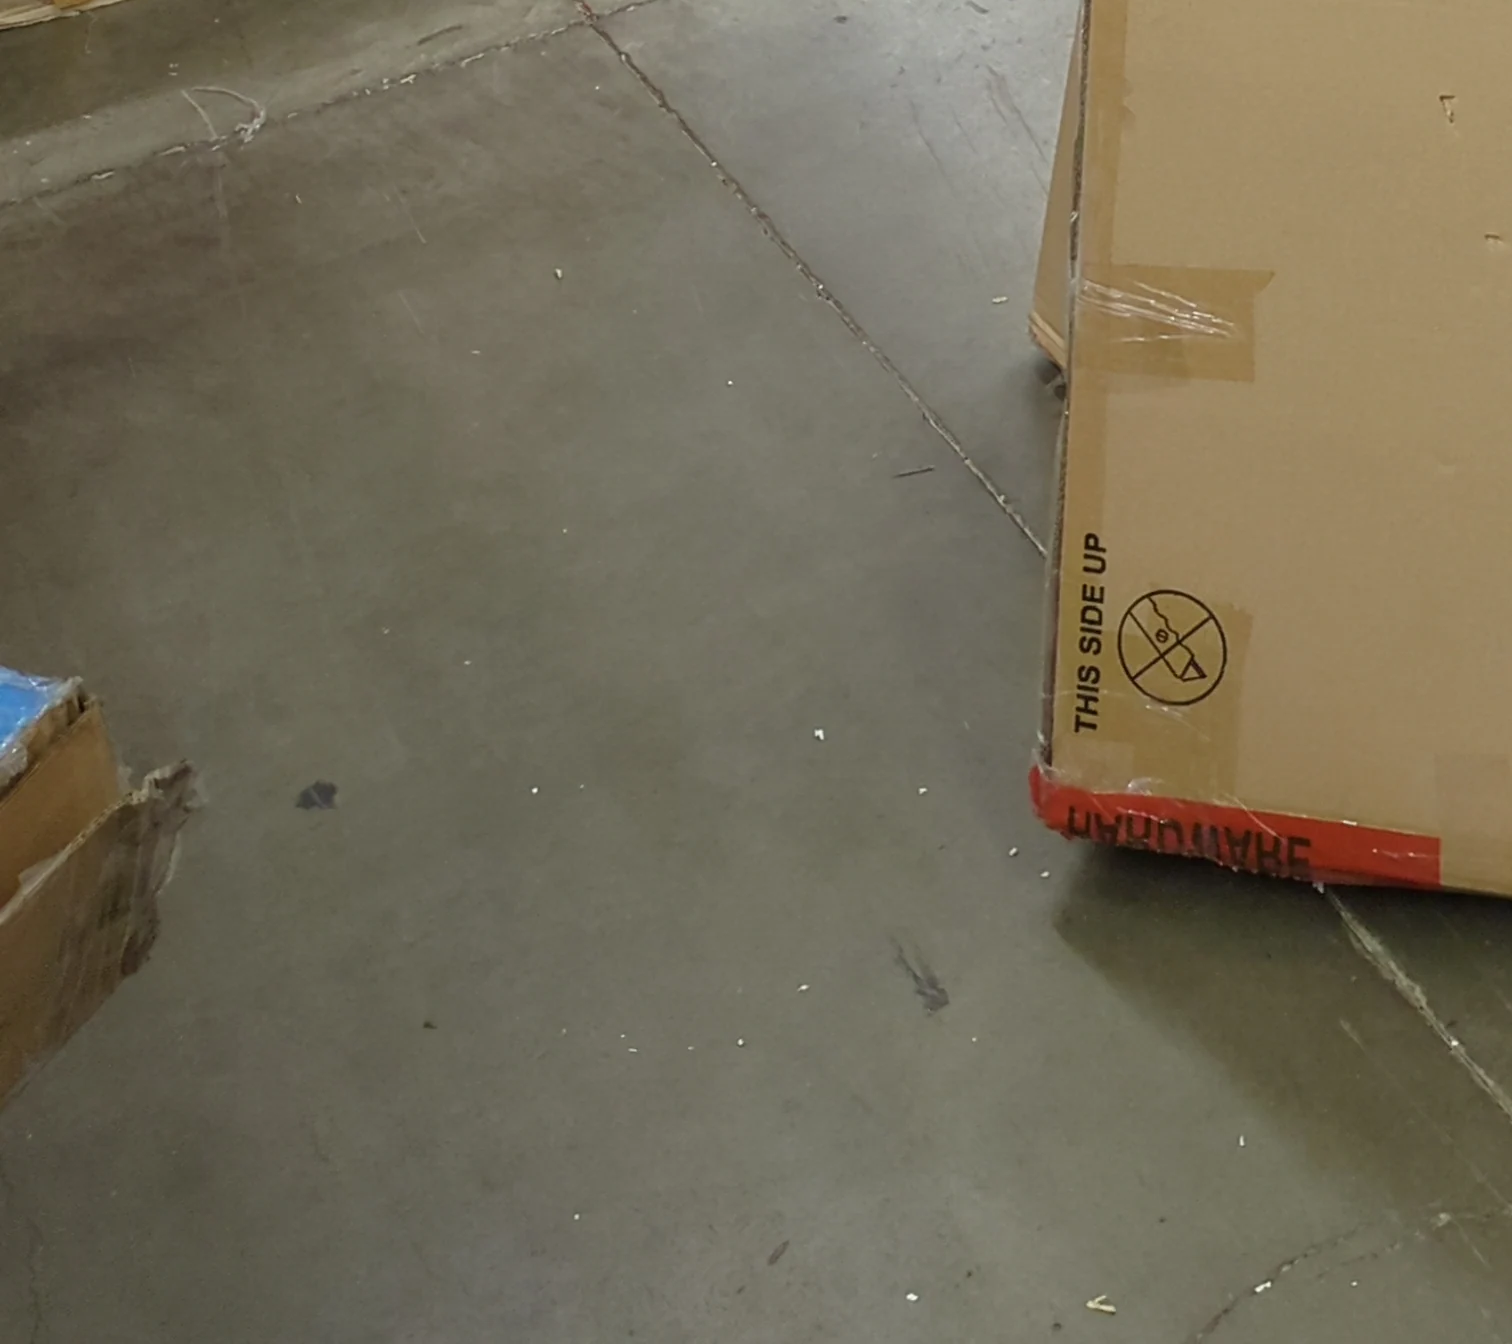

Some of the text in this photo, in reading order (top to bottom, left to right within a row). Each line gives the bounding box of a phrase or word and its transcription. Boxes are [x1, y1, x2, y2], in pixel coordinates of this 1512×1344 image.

[1074, 532, 1109, 734] THIS SIDE UP
